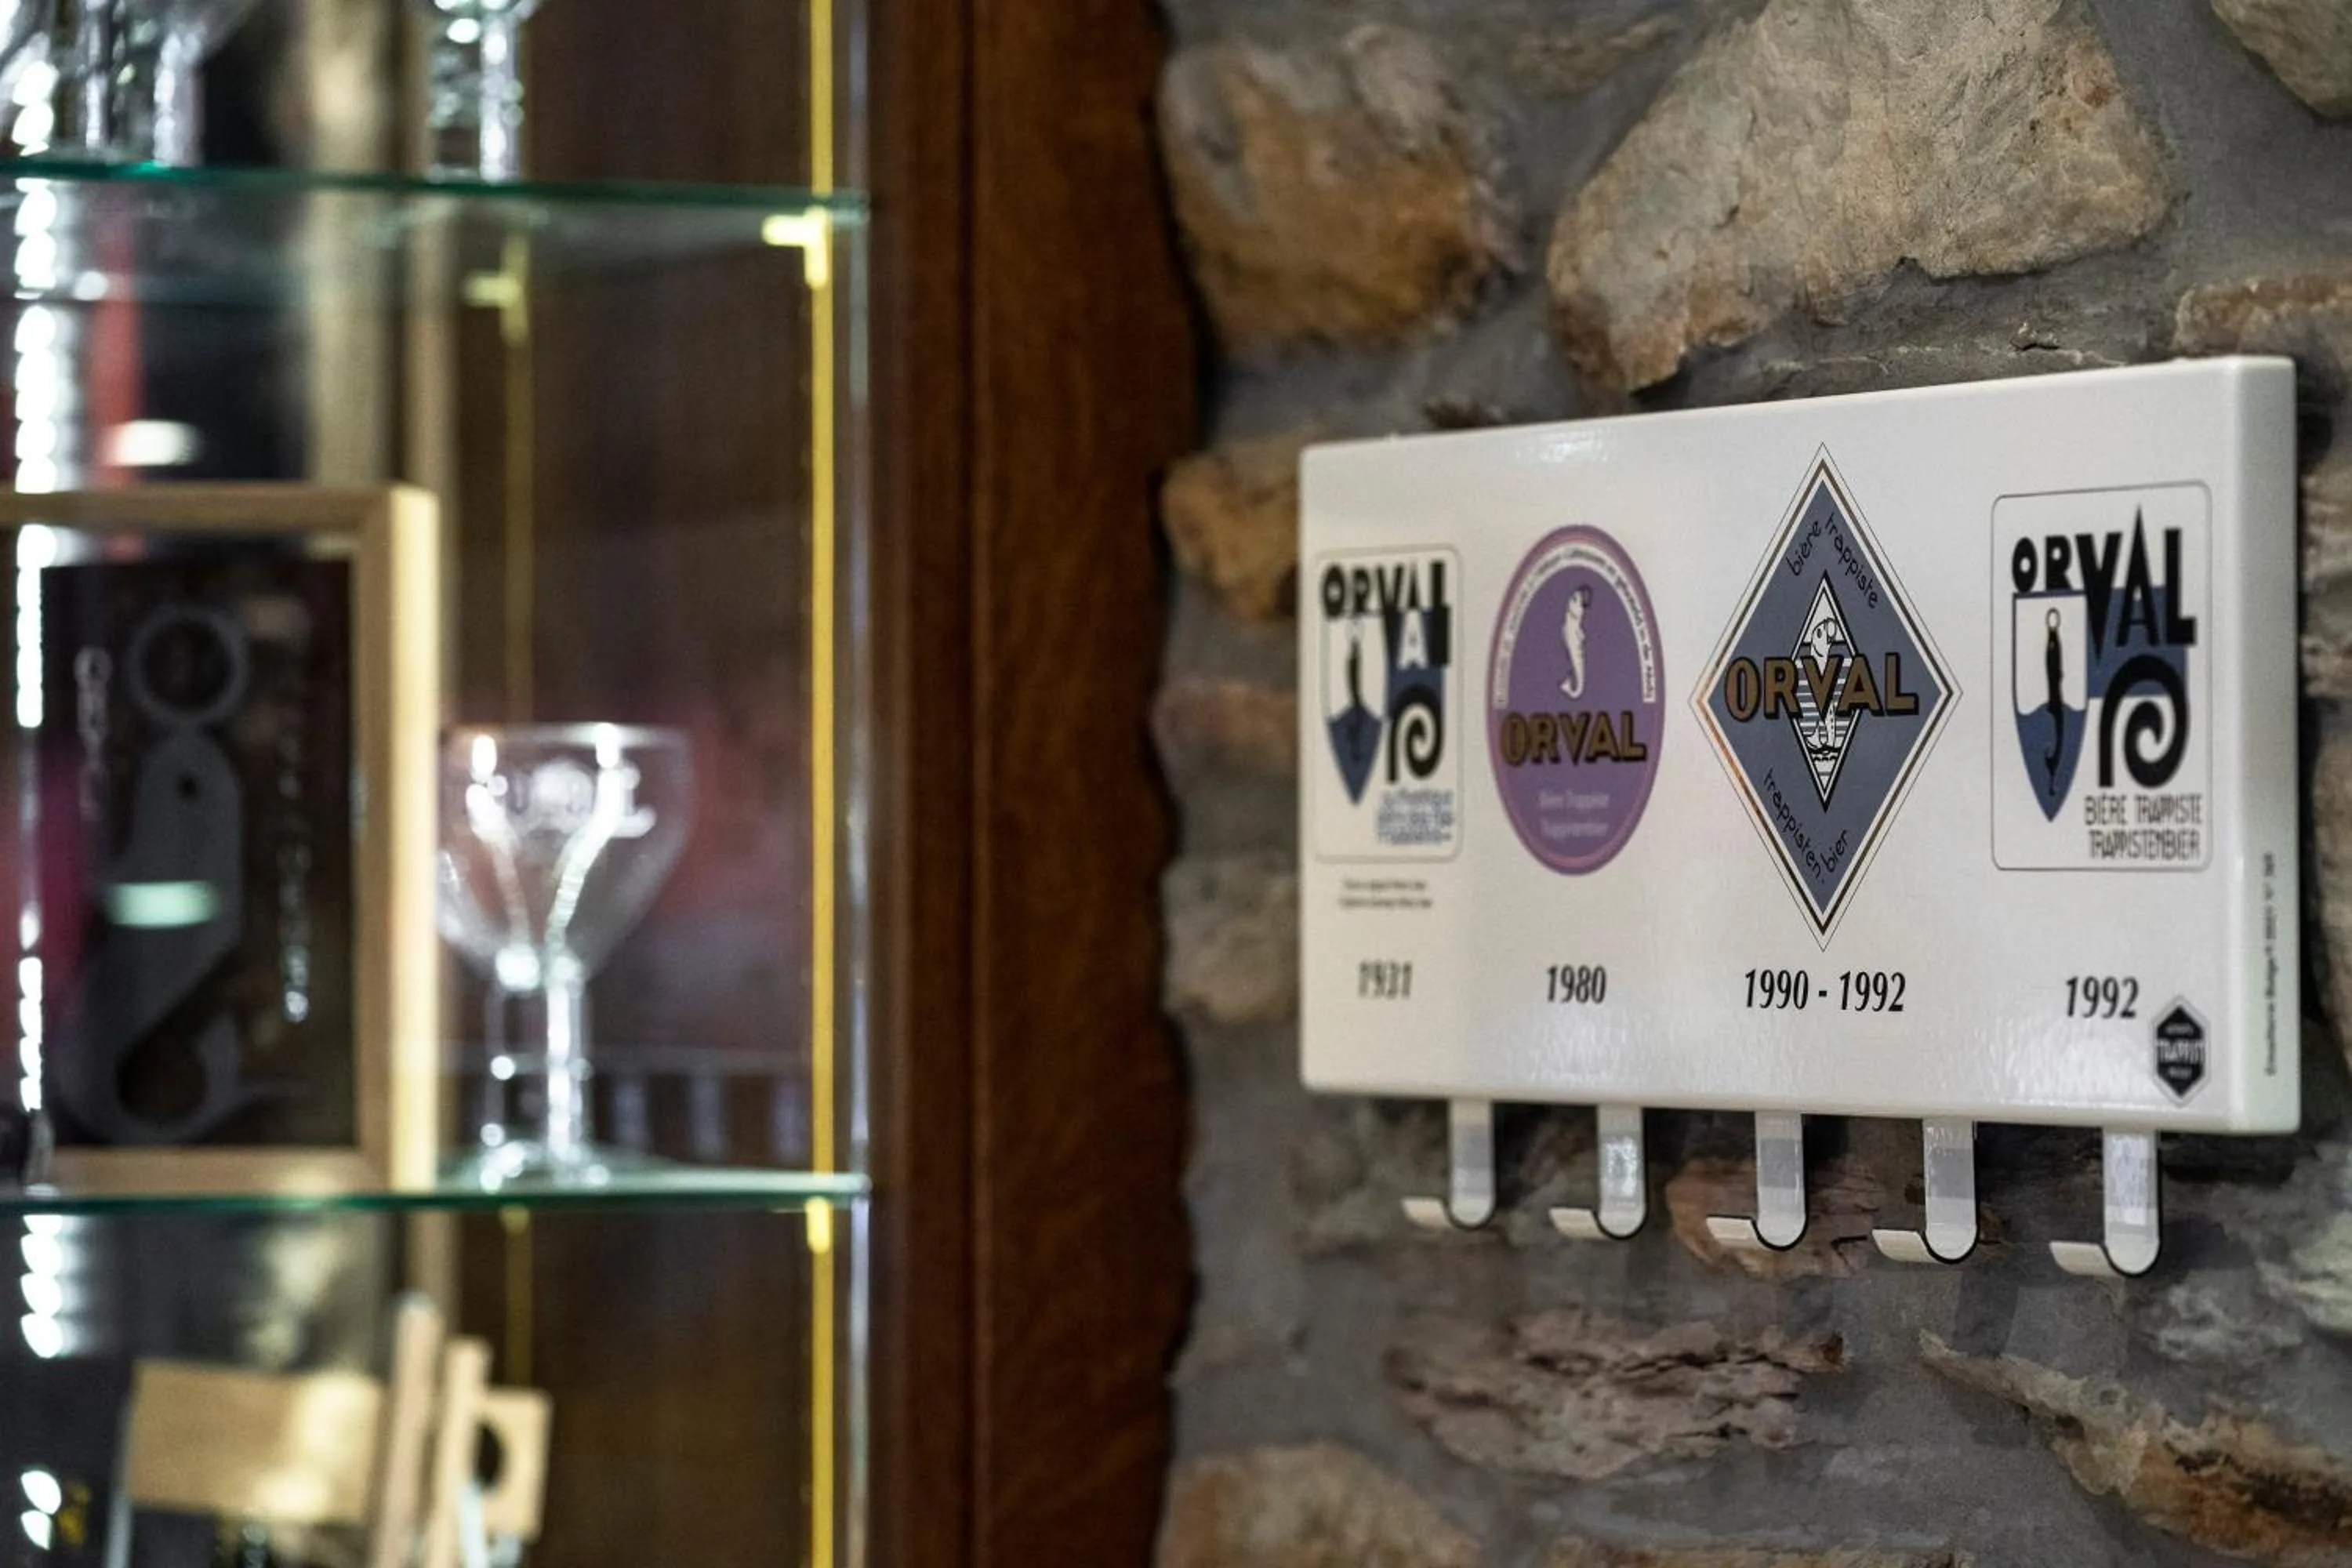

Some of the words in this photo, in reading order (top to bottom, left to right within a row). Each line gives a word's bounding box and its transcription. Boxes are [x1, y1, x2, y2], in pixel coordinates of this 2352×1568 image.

[1824, 512, 1878, 609] trappiste
[2012, 503, 2198, 662] ORVAL
[1320, 561, 1450, 669] ORVAL
[1725, 652, 1918, 723] ORVAL
[1501, 710, 1649, 767] ORVAL
[2135, 792, 2201, 826] TRAPPISTE
[1820, 829, 1848, 873] bier
[2089, 828, 2201, 861] TRAPPISTENBIER
[1546, 964, 1607, 1004] 1980
[1745, 968, 1809, 1010] 1990
[1839, 970, 1906, 1012] 1992
[2066, 975, 2140, 1019] 1992
